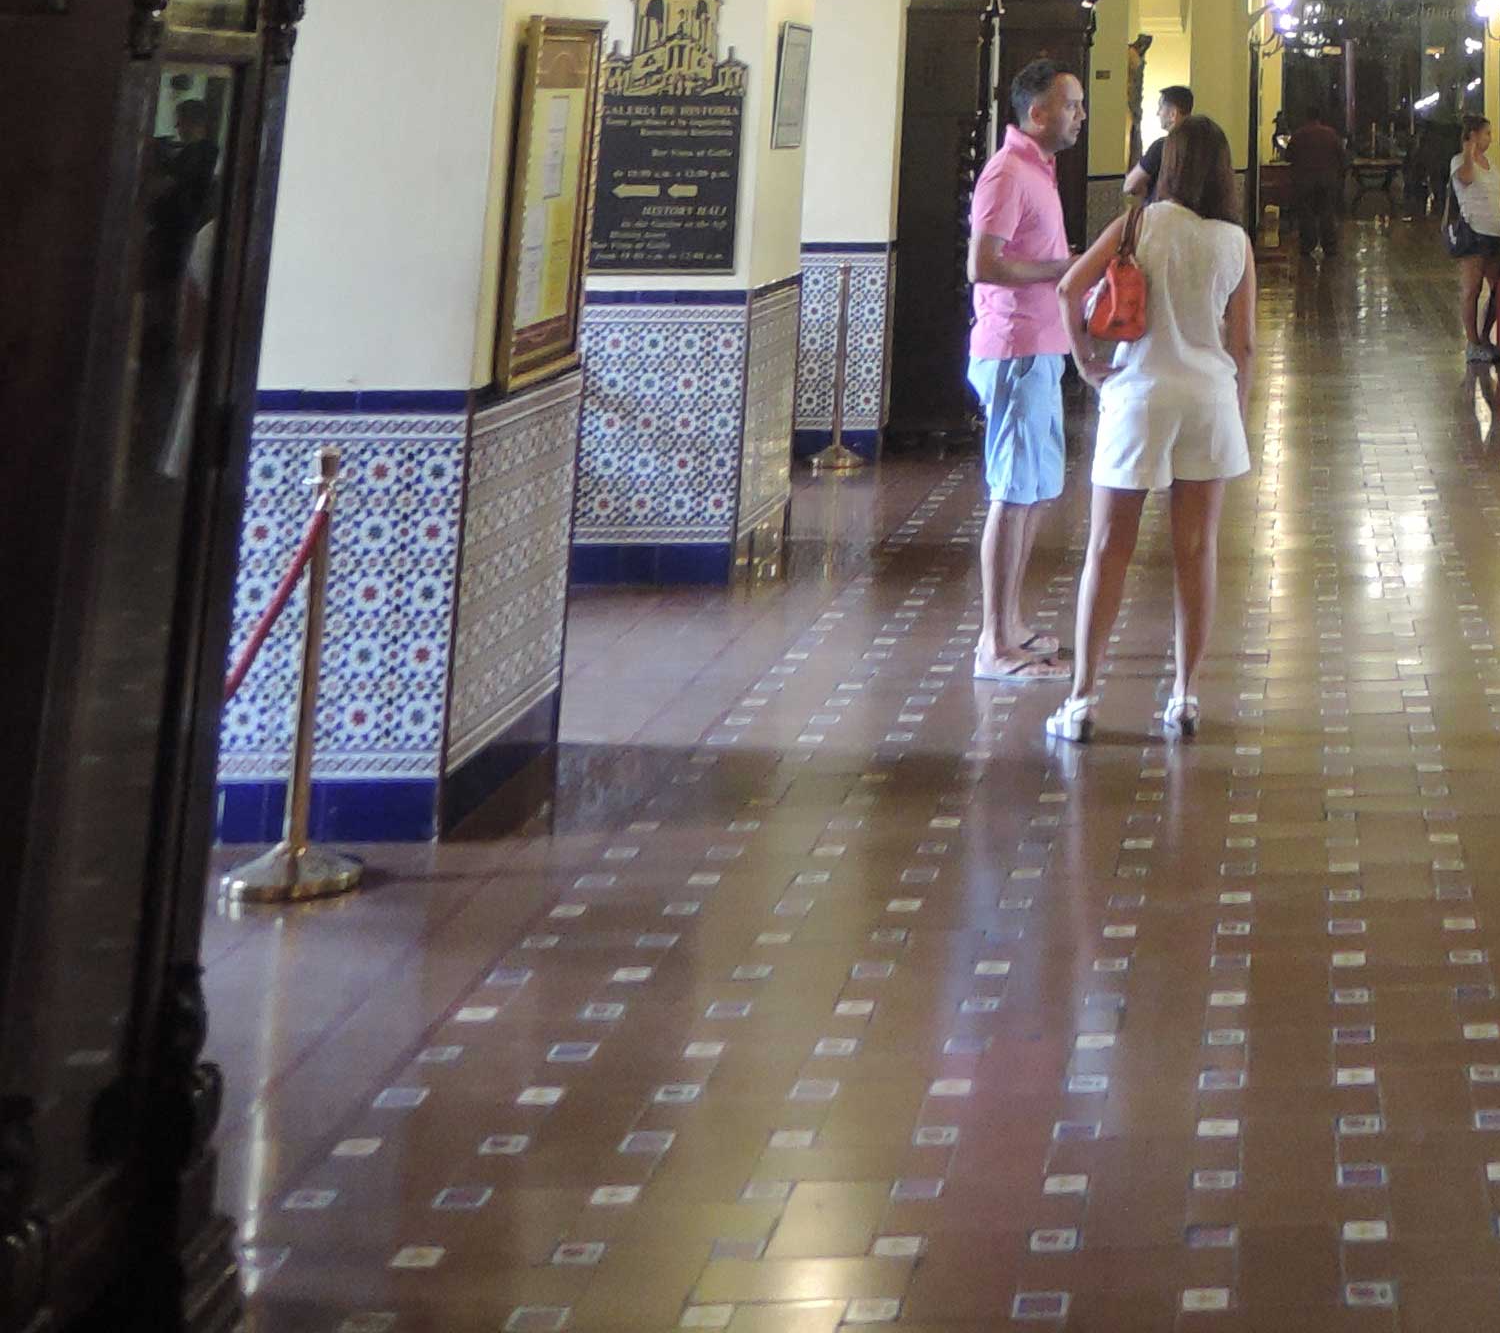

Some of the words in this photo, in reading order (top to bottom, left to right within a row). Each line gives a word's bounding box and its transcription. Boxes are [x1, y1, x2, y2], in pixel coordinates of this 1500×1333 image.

[660, 105, 674, 115] DE
[680, 105, 739, 115] HISTORIA
[642, 206, 693, 215] HISTORY
